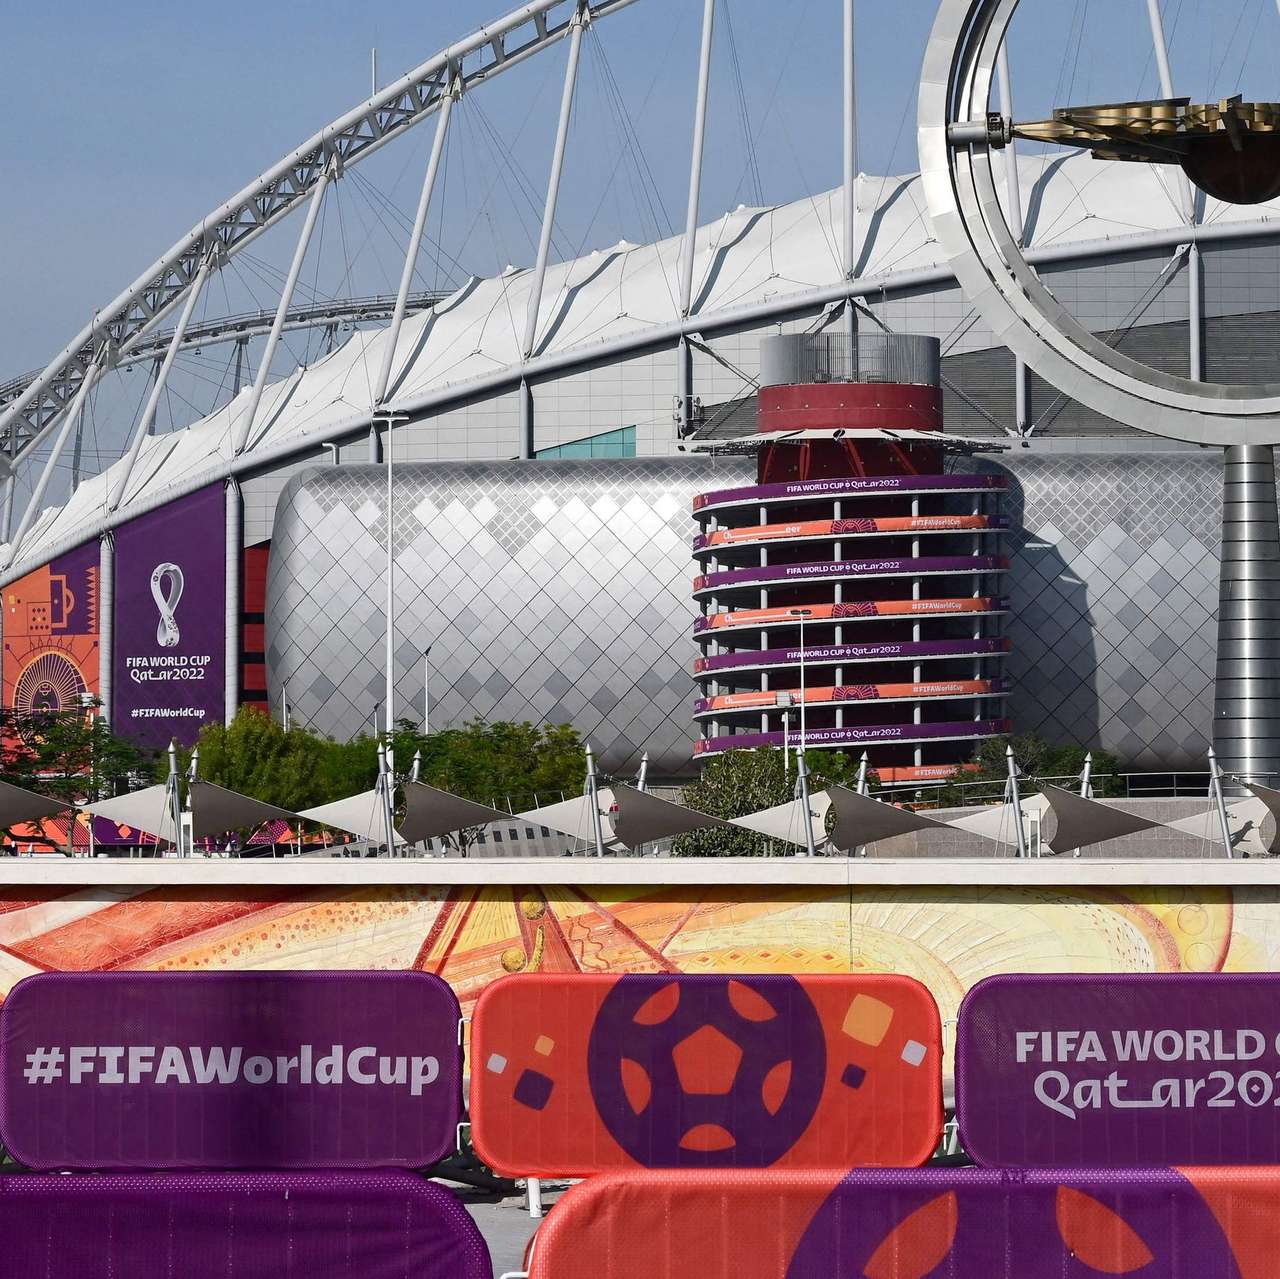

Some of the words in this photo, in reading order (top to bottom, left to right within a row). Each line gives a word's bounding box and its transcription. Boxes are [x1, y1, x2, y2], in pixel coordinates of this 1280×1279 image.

[802, 484, 829, 492] WORLD
[802, 566, 829, 574] WORLD
[830, 564, 845, 572] CUP
[802, 650, 829, 658] WORLD
[126, 658, 149, 667] FIFA
[150, 656, 188, 667] WORLD
[190, 656, 210, 666] CUP
[130, 668, 205, 684] Qatar2022
[131, 708, 206, 719] #FIFAWorldCup
[1015, 1030, 1107, 1063] FIFA
[1112, 1030, 1266, 1062] WORLD
[24, 1044, 440, 1096] #FIFAWorldCup
